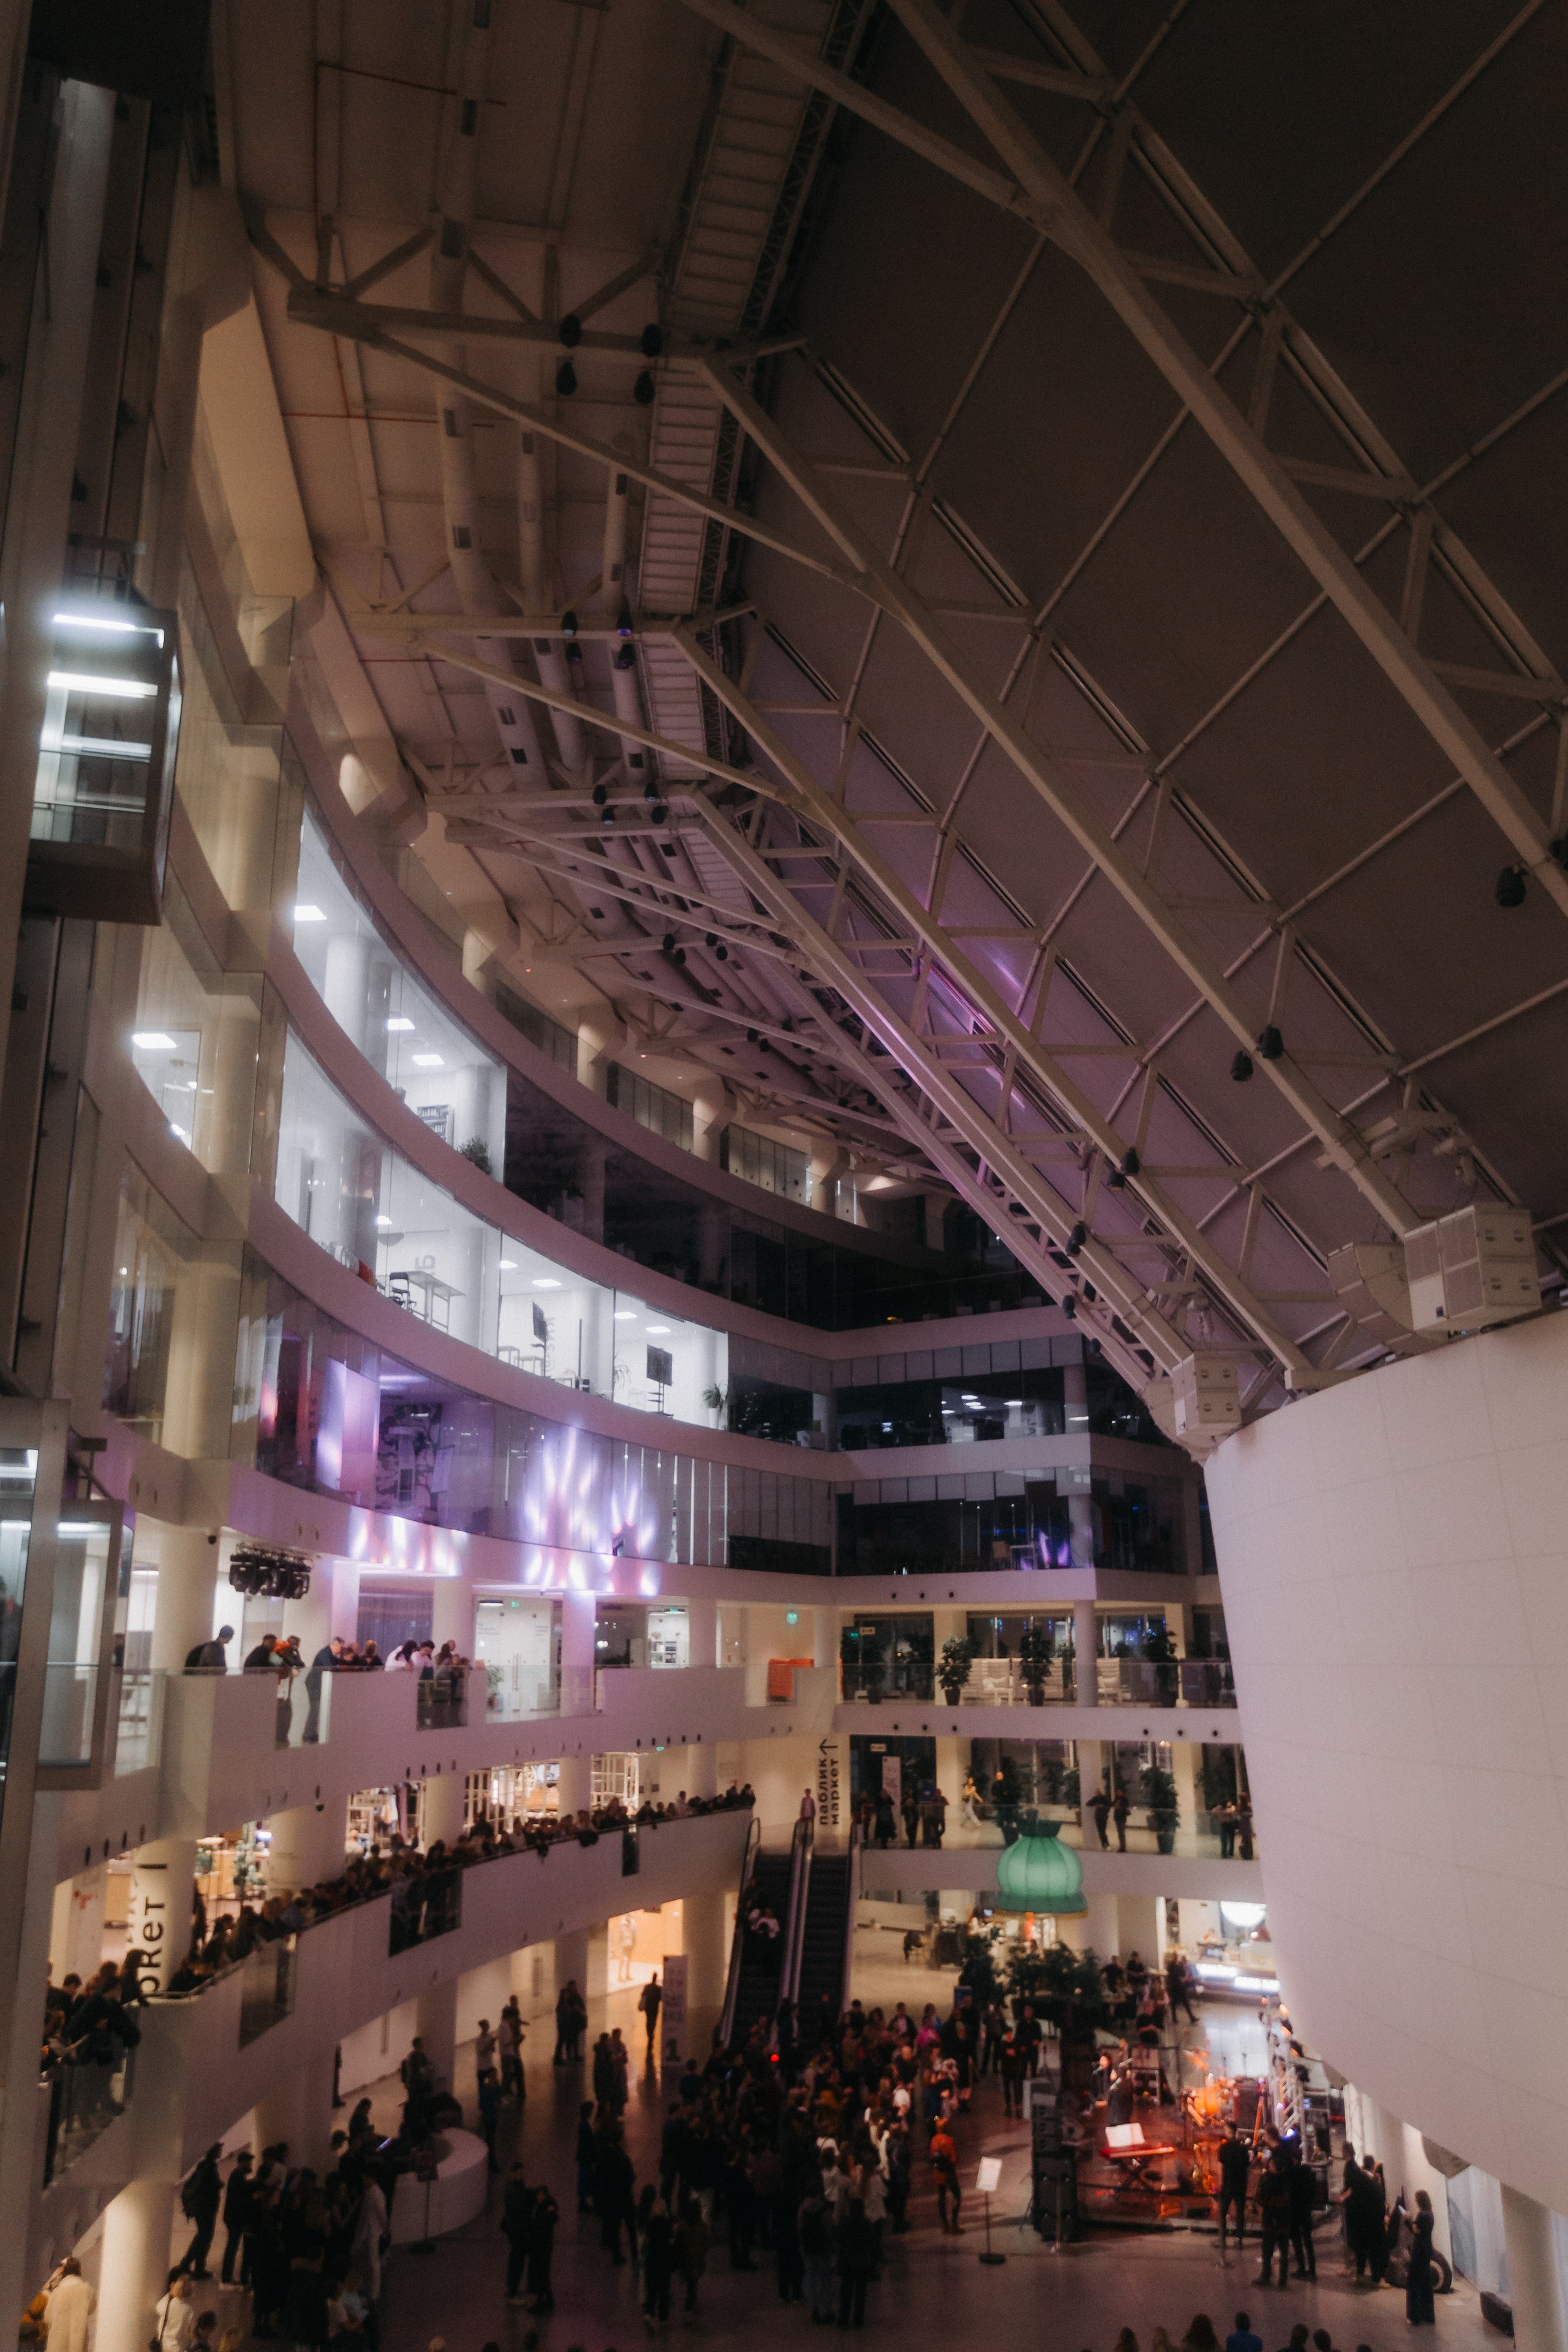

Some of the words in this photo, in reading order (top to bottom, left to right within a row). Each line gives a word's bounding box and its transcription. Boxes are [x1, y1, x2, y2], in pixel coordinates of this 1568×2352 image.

[819, 1758, 828, 1825] паблик
[830, 1758, 840, 1825] маркет
[138, 1896, 165, 1998] ркет
